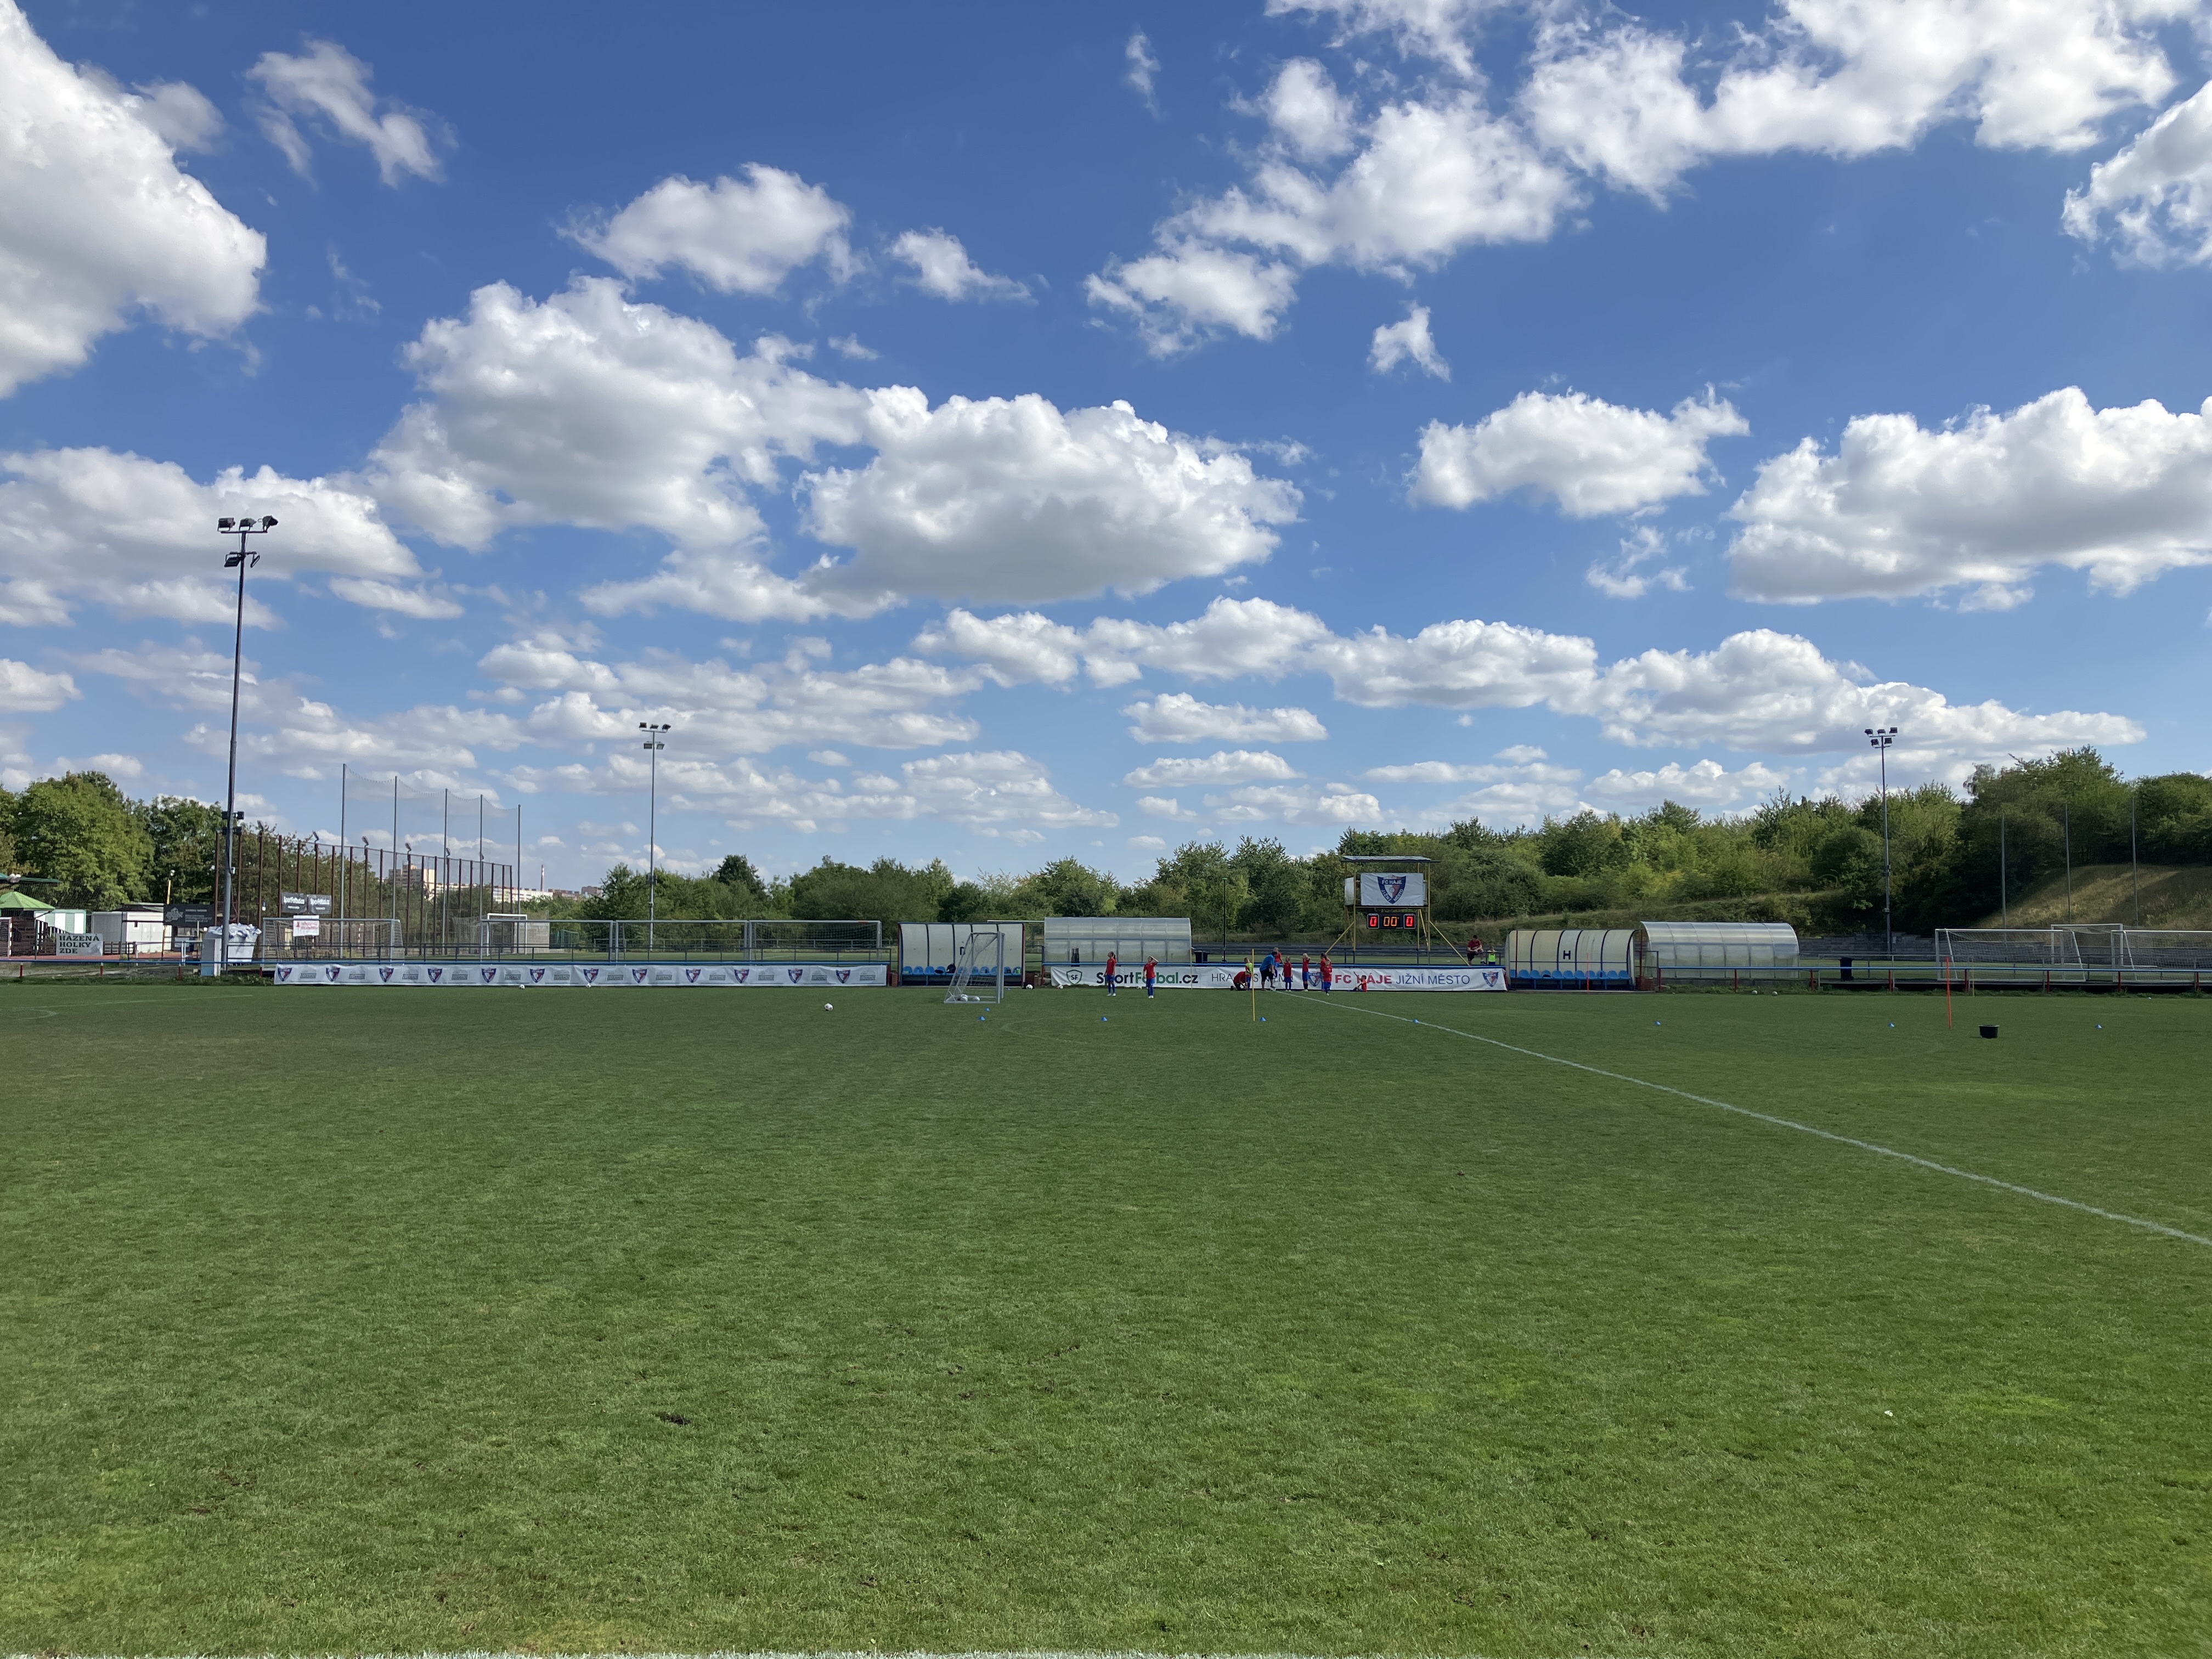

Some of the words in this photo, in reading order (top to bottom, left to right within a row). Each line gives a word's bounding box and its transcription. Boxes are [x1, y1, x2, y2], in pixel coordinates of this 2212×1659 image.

[1370, 917, 1377, 927] 0
[1406, 917, 1413, 927] 0
[1563, 950, 1571, 960] H
[1096, 972, 1198, 985] SortFbal.cz
[1335, 974, 1352, 984] FC
[1396, 973, 1424, 984] JIŽNÍ
[1428, 973, 1470, 985] MĚSTO
